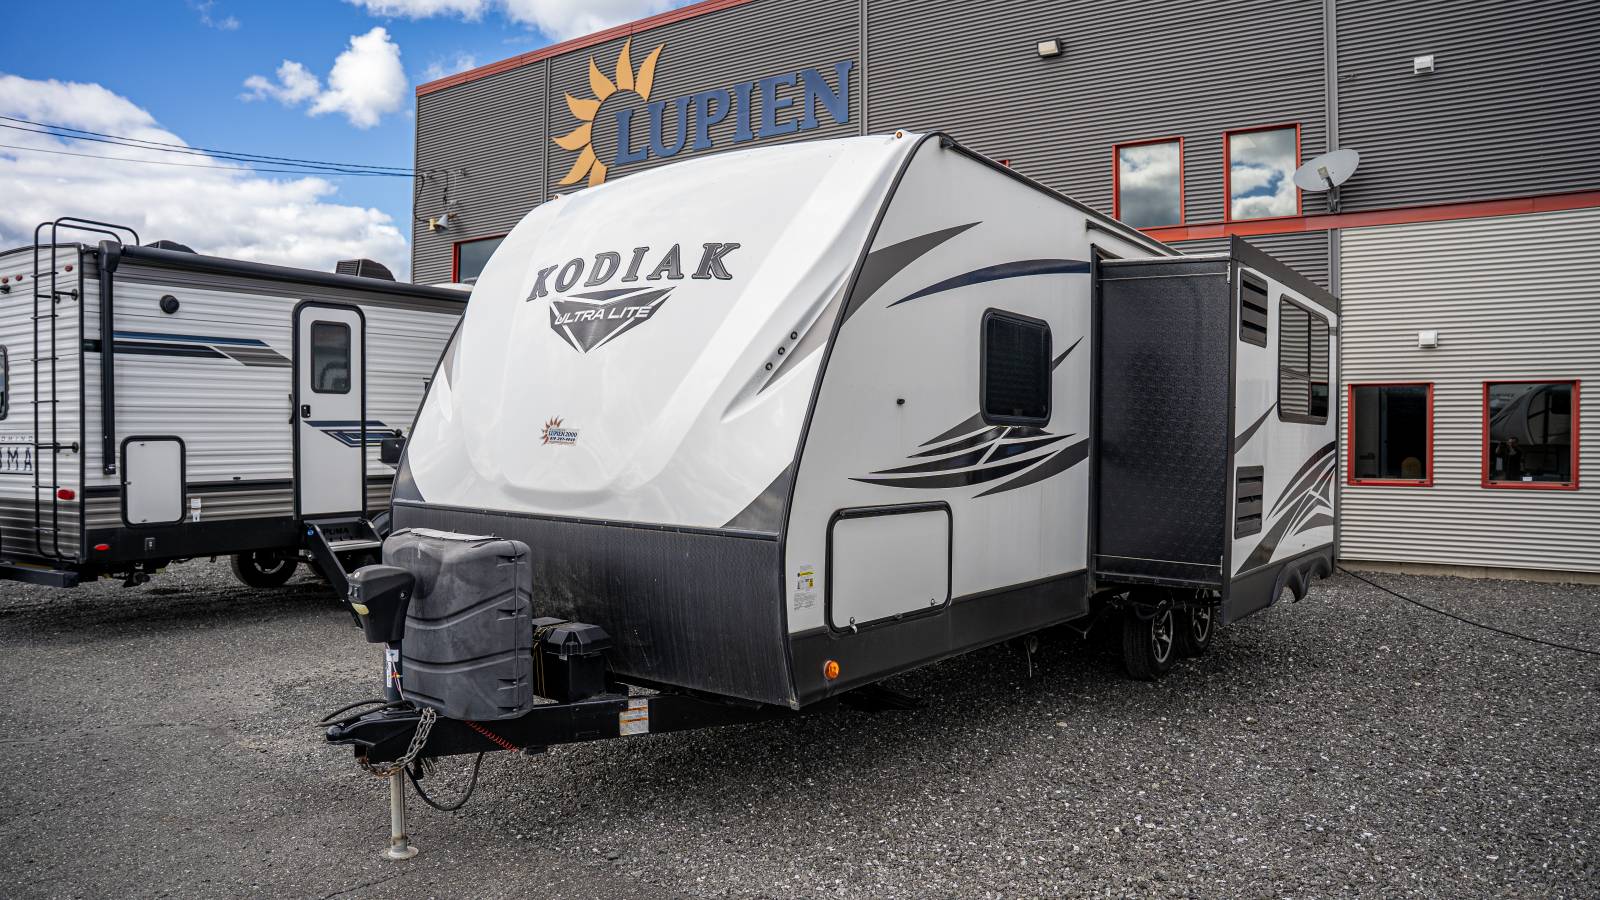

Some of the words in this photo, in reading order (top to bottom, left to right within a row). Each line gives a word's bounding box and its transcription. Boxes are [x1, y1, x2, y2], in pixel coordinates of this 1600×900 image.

[614, 60, 853, 167] LUPIEN
[526, 243, 741, 302] KODIAK
[554, 308, 605, 325] ULTRA
[607, 305, 653, 320] LITE
[0, 447, 32, 471] MA
